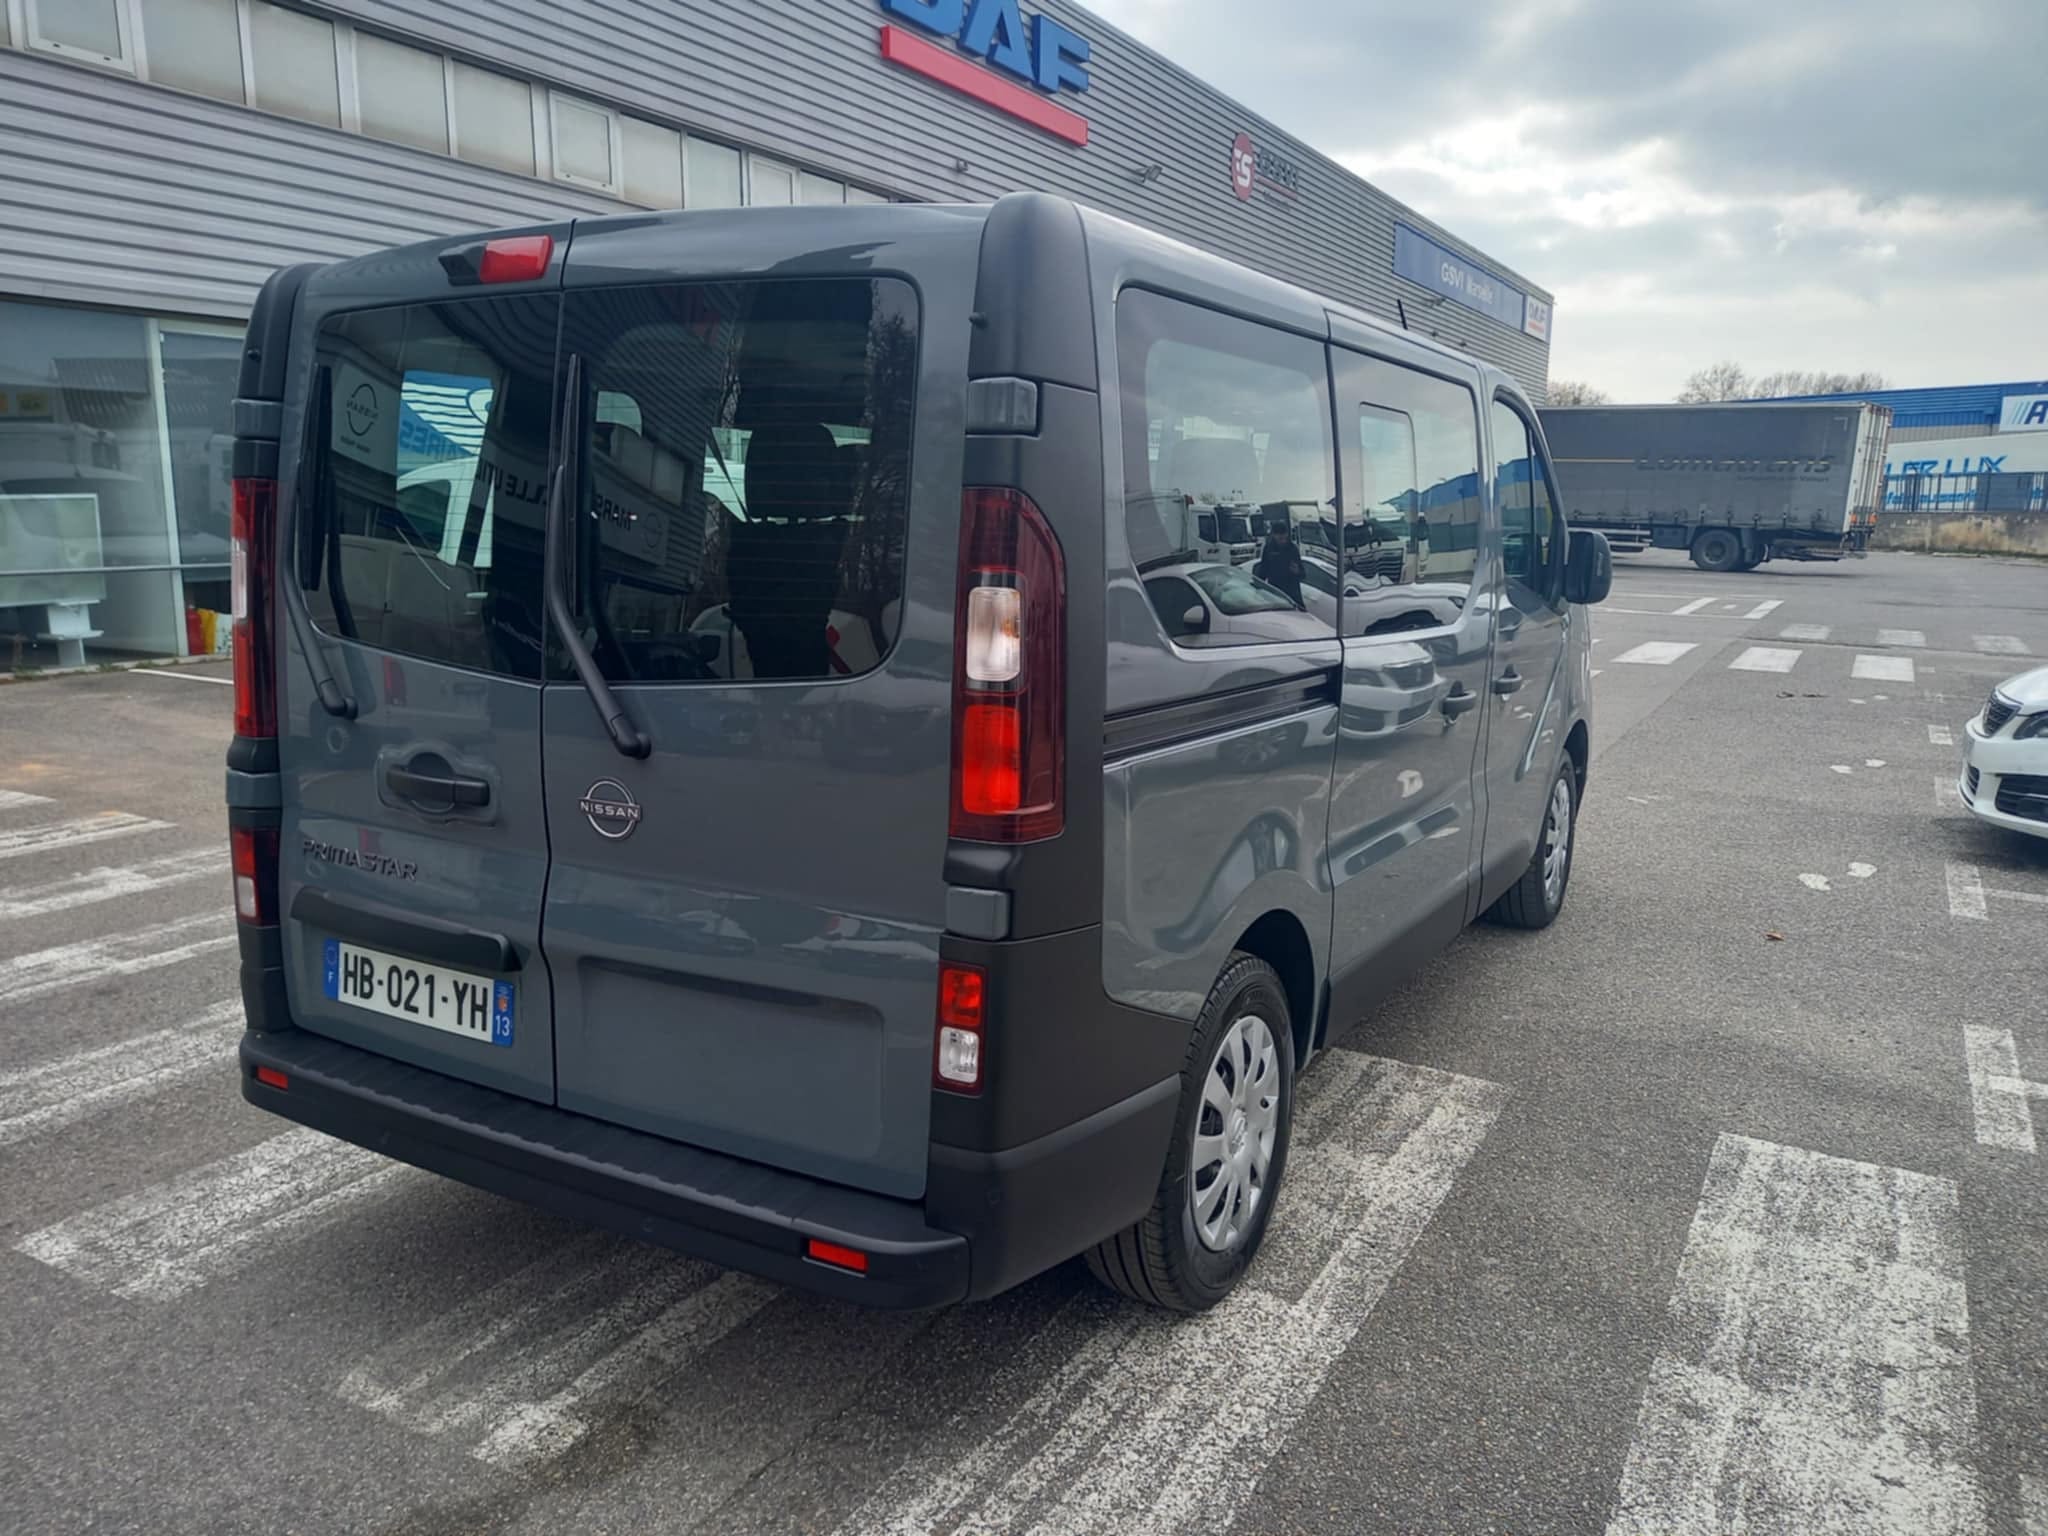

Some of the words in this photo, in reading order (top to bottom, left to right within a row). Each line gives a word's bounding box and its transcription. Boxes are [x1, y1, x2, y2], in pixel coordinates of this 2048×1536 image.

[580, 800, 638, 818] NISSAN
[343, 951, 489, 1032] HB-021-YH
[495, 1015, 511, 1037] 13
